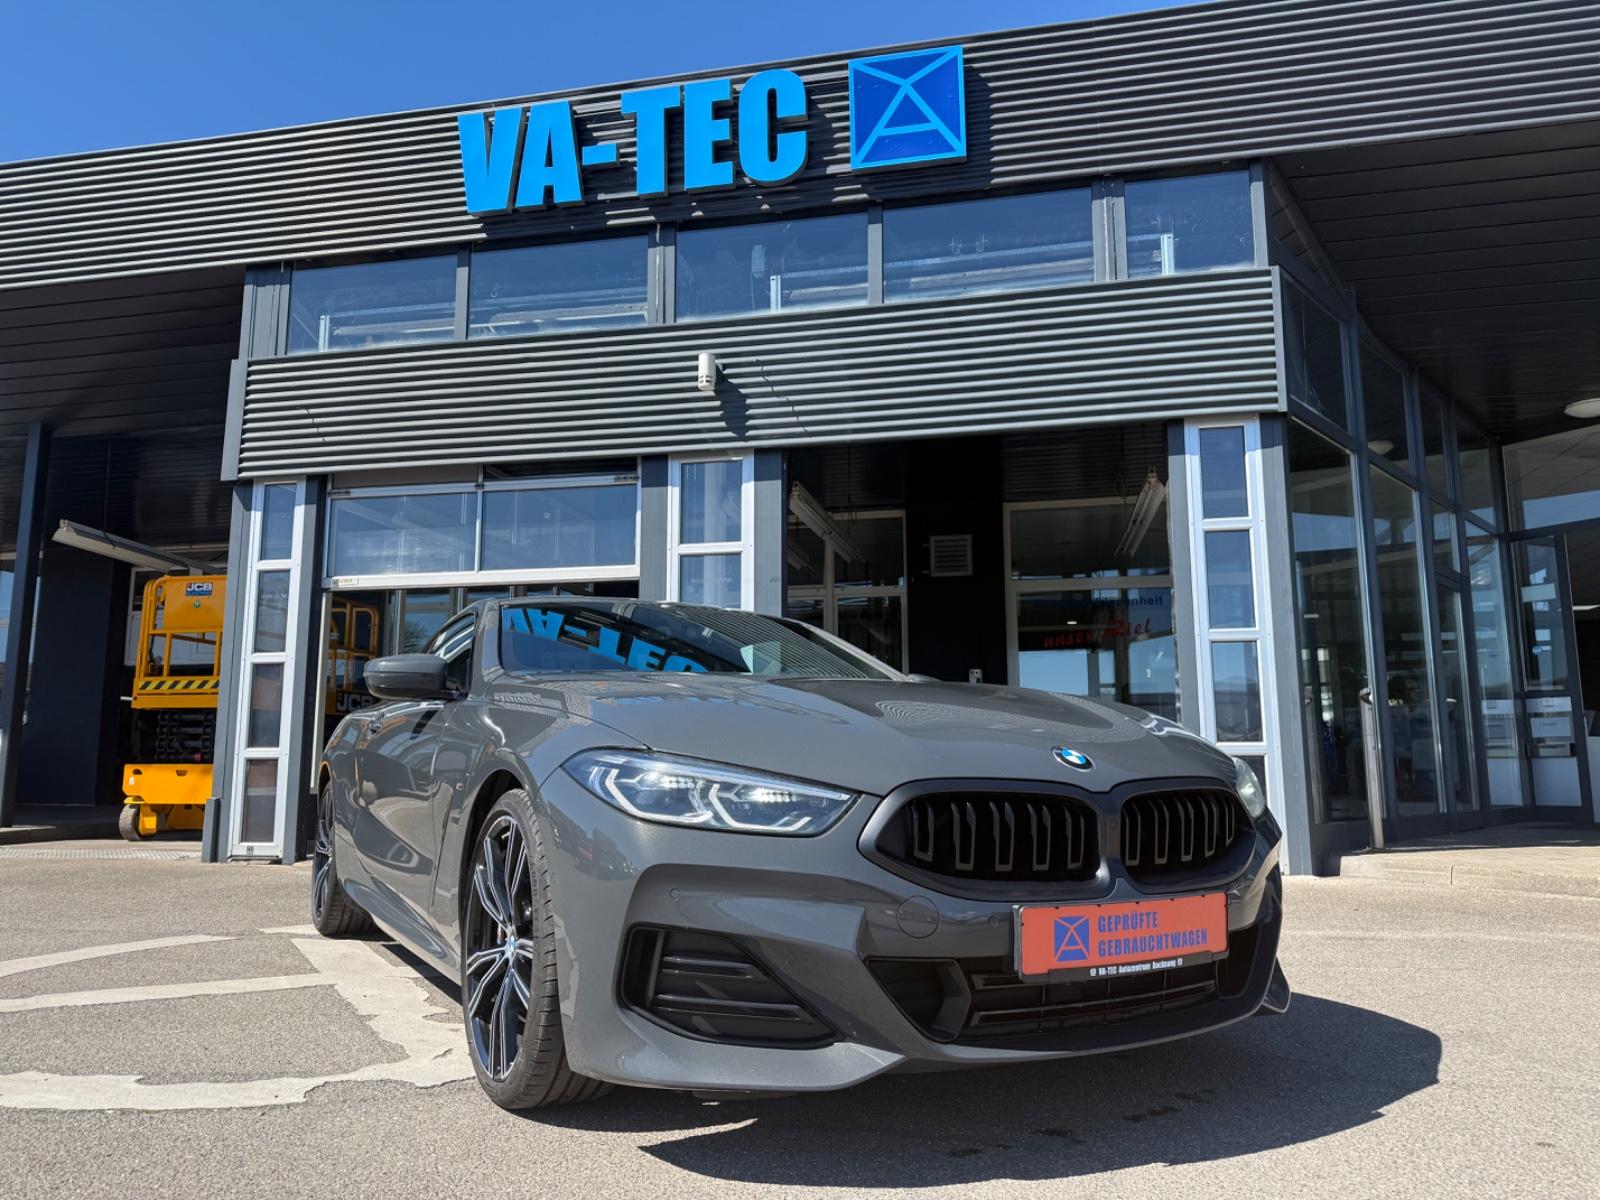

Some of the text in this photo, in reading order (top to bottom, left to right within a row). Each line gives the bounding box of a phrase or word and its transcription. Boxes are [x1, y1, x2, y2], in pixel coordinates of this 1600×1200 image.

[458, 69, 807, 213] VA-TEC
[187, 583, 212, 591] JCB
[1098, 911, 1158, 932] GEPRÜFTE
[1098, 928, 1207, 957] GEBRAUCHTWAGEN
